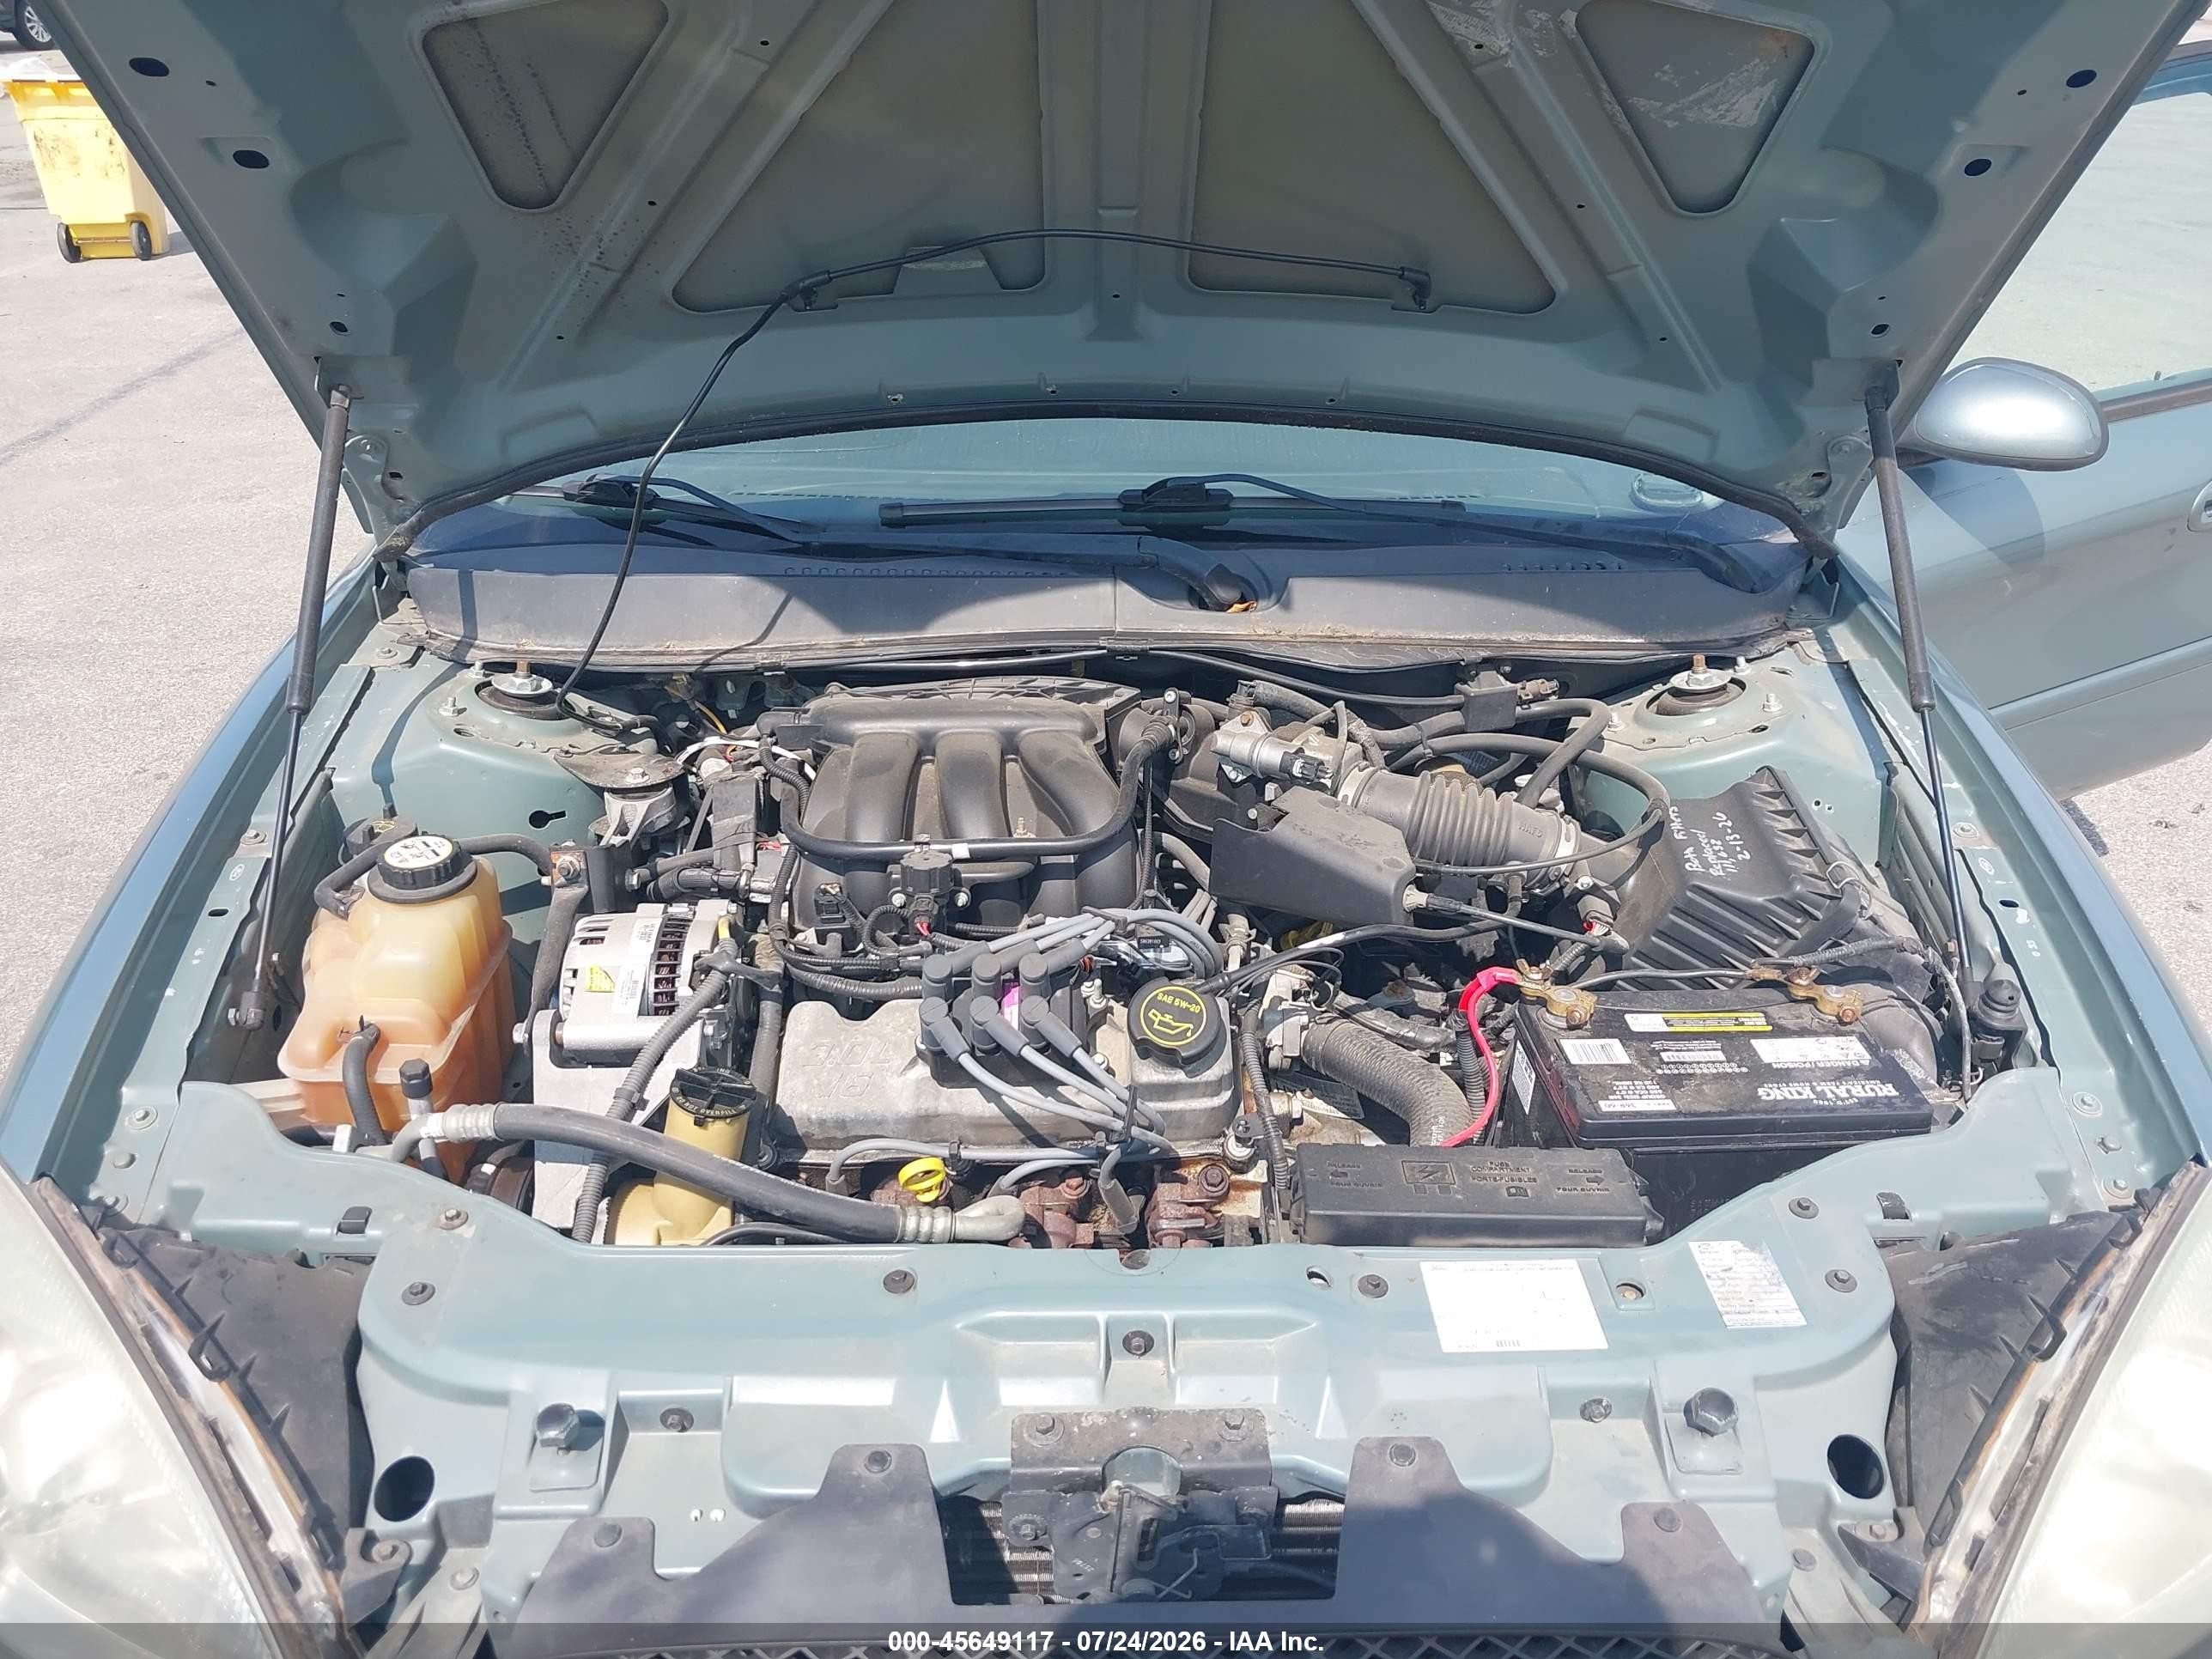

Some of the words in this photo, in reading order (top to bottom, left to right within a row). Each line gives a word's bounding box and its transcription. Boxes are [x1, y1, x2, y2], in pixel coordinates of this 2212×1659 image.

[1157, 993, 1174, 1004] SAE
[1174, 998, 1201, 1013] 5W-20
[1757, 1086, 1816, 1105] KING
[1816, 1083, 1899, 1099] RURAL
